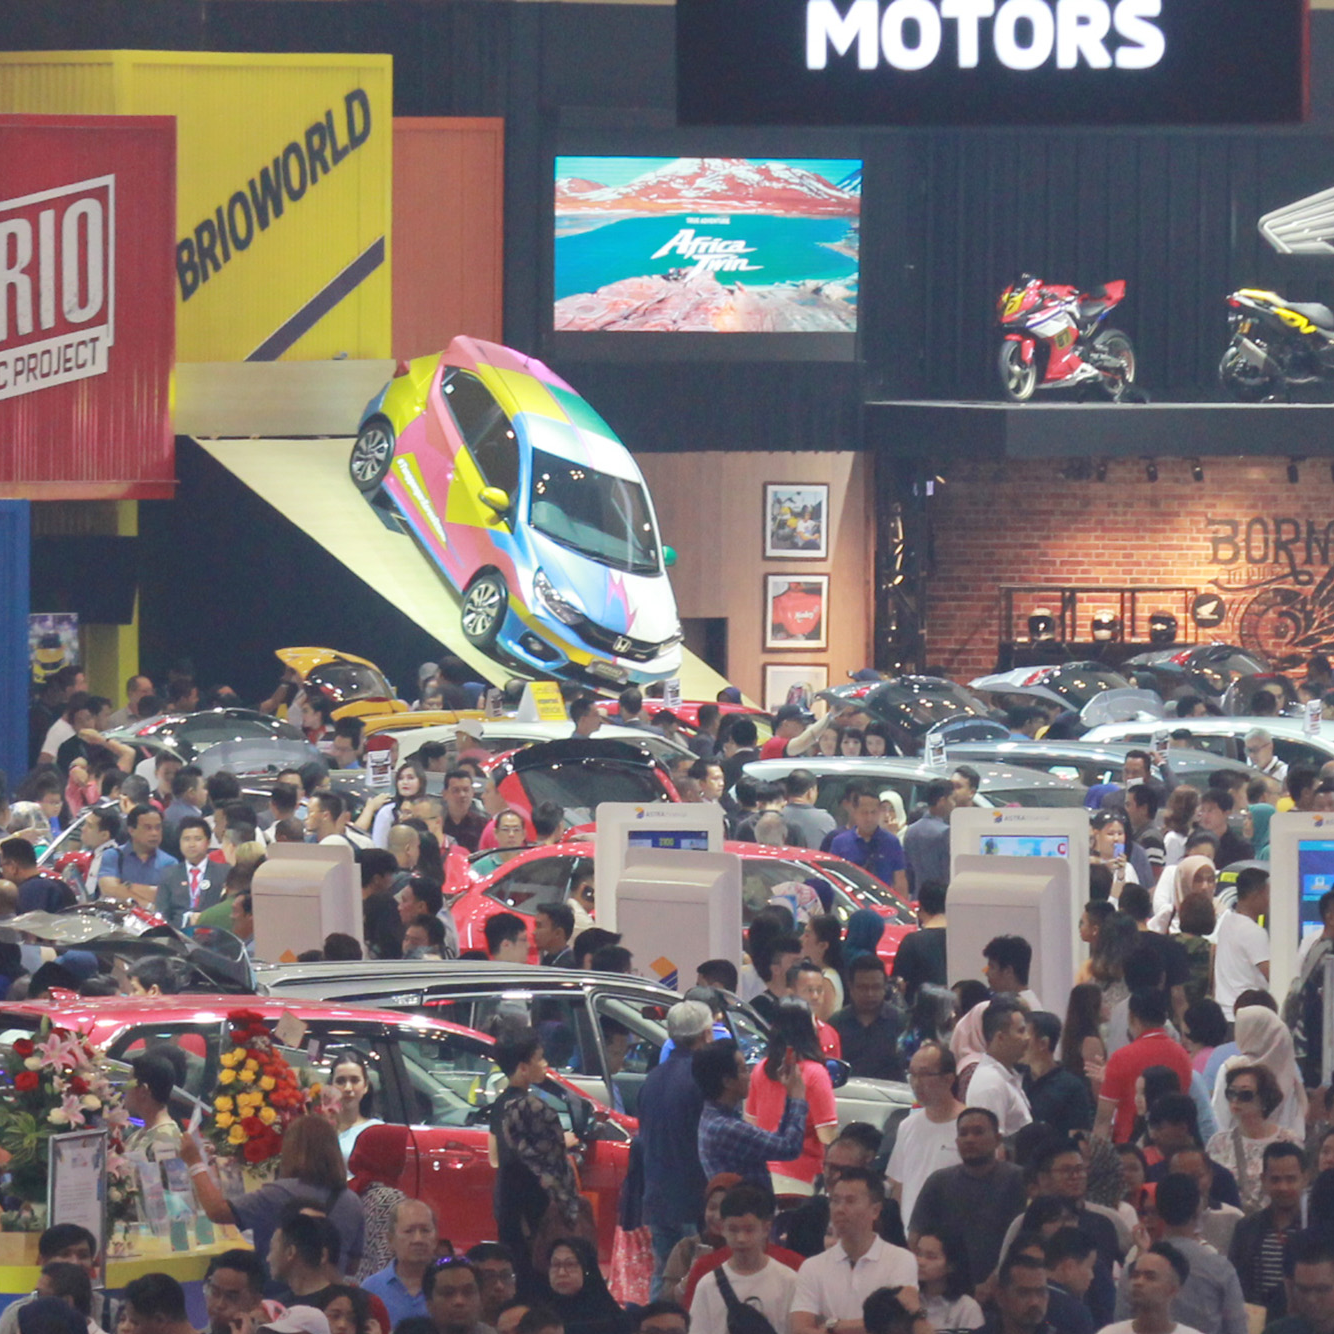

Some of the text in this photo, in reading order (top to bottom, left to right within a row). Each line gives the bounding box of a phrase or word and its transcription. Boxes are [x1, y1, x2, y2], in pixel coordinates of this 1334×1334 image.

[804, 0, 1166, 71] MOTORS
[176, 88, 371, 302] BRIOWORLD
[650, 228, 758, 260] Africa
[684, 252, 765, 282] Twin
[13, 337, 100, 386] PROJECT
